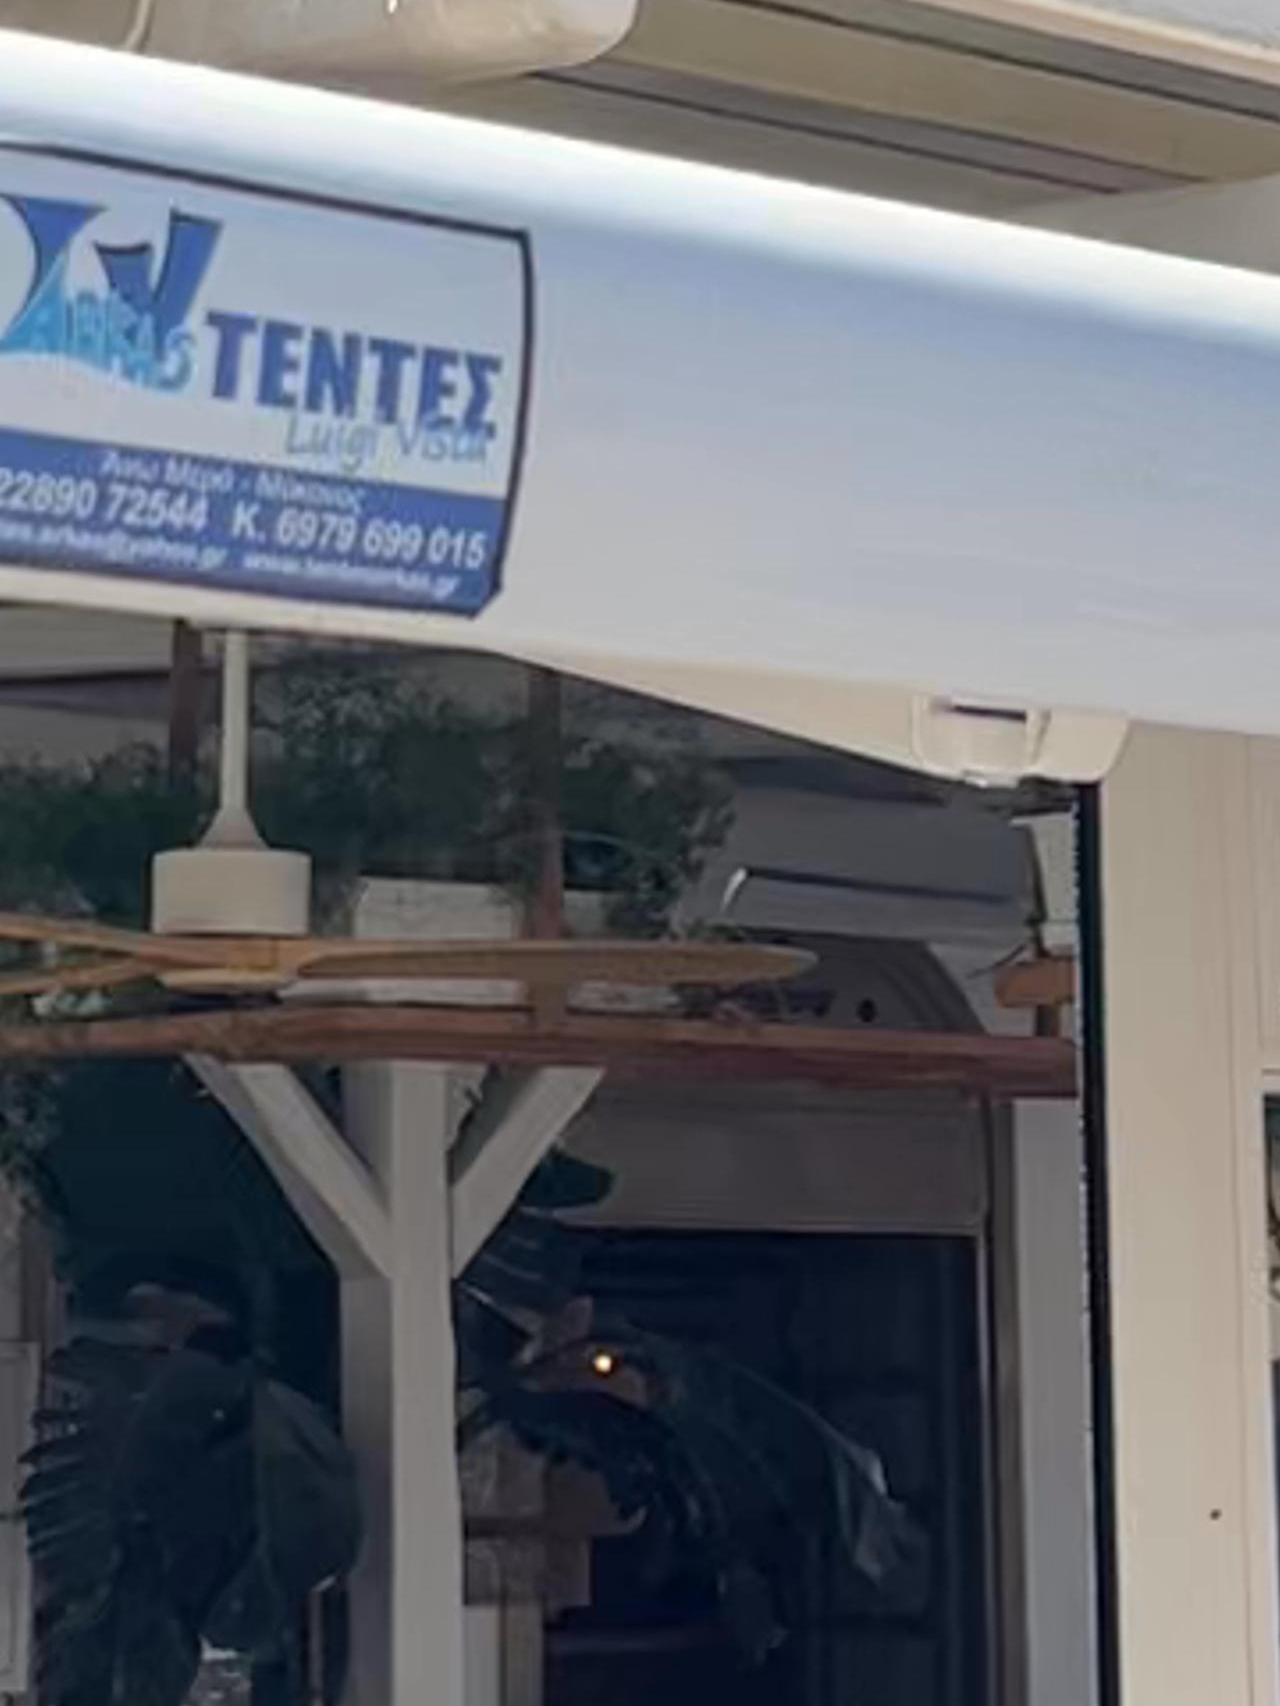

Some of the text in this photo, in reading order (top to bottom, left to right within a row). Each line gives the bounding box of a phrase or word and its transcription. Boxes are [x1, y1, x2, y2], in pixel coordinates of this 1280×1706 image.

[205, 309, 503, 440] ΤΕΝΤΕΣ
[106, 485, 210, 533] 72544
[277, 507, 358, 553] 6979
[363, 516, 424, 562] 699
[427, 526, 488, 570] 015
